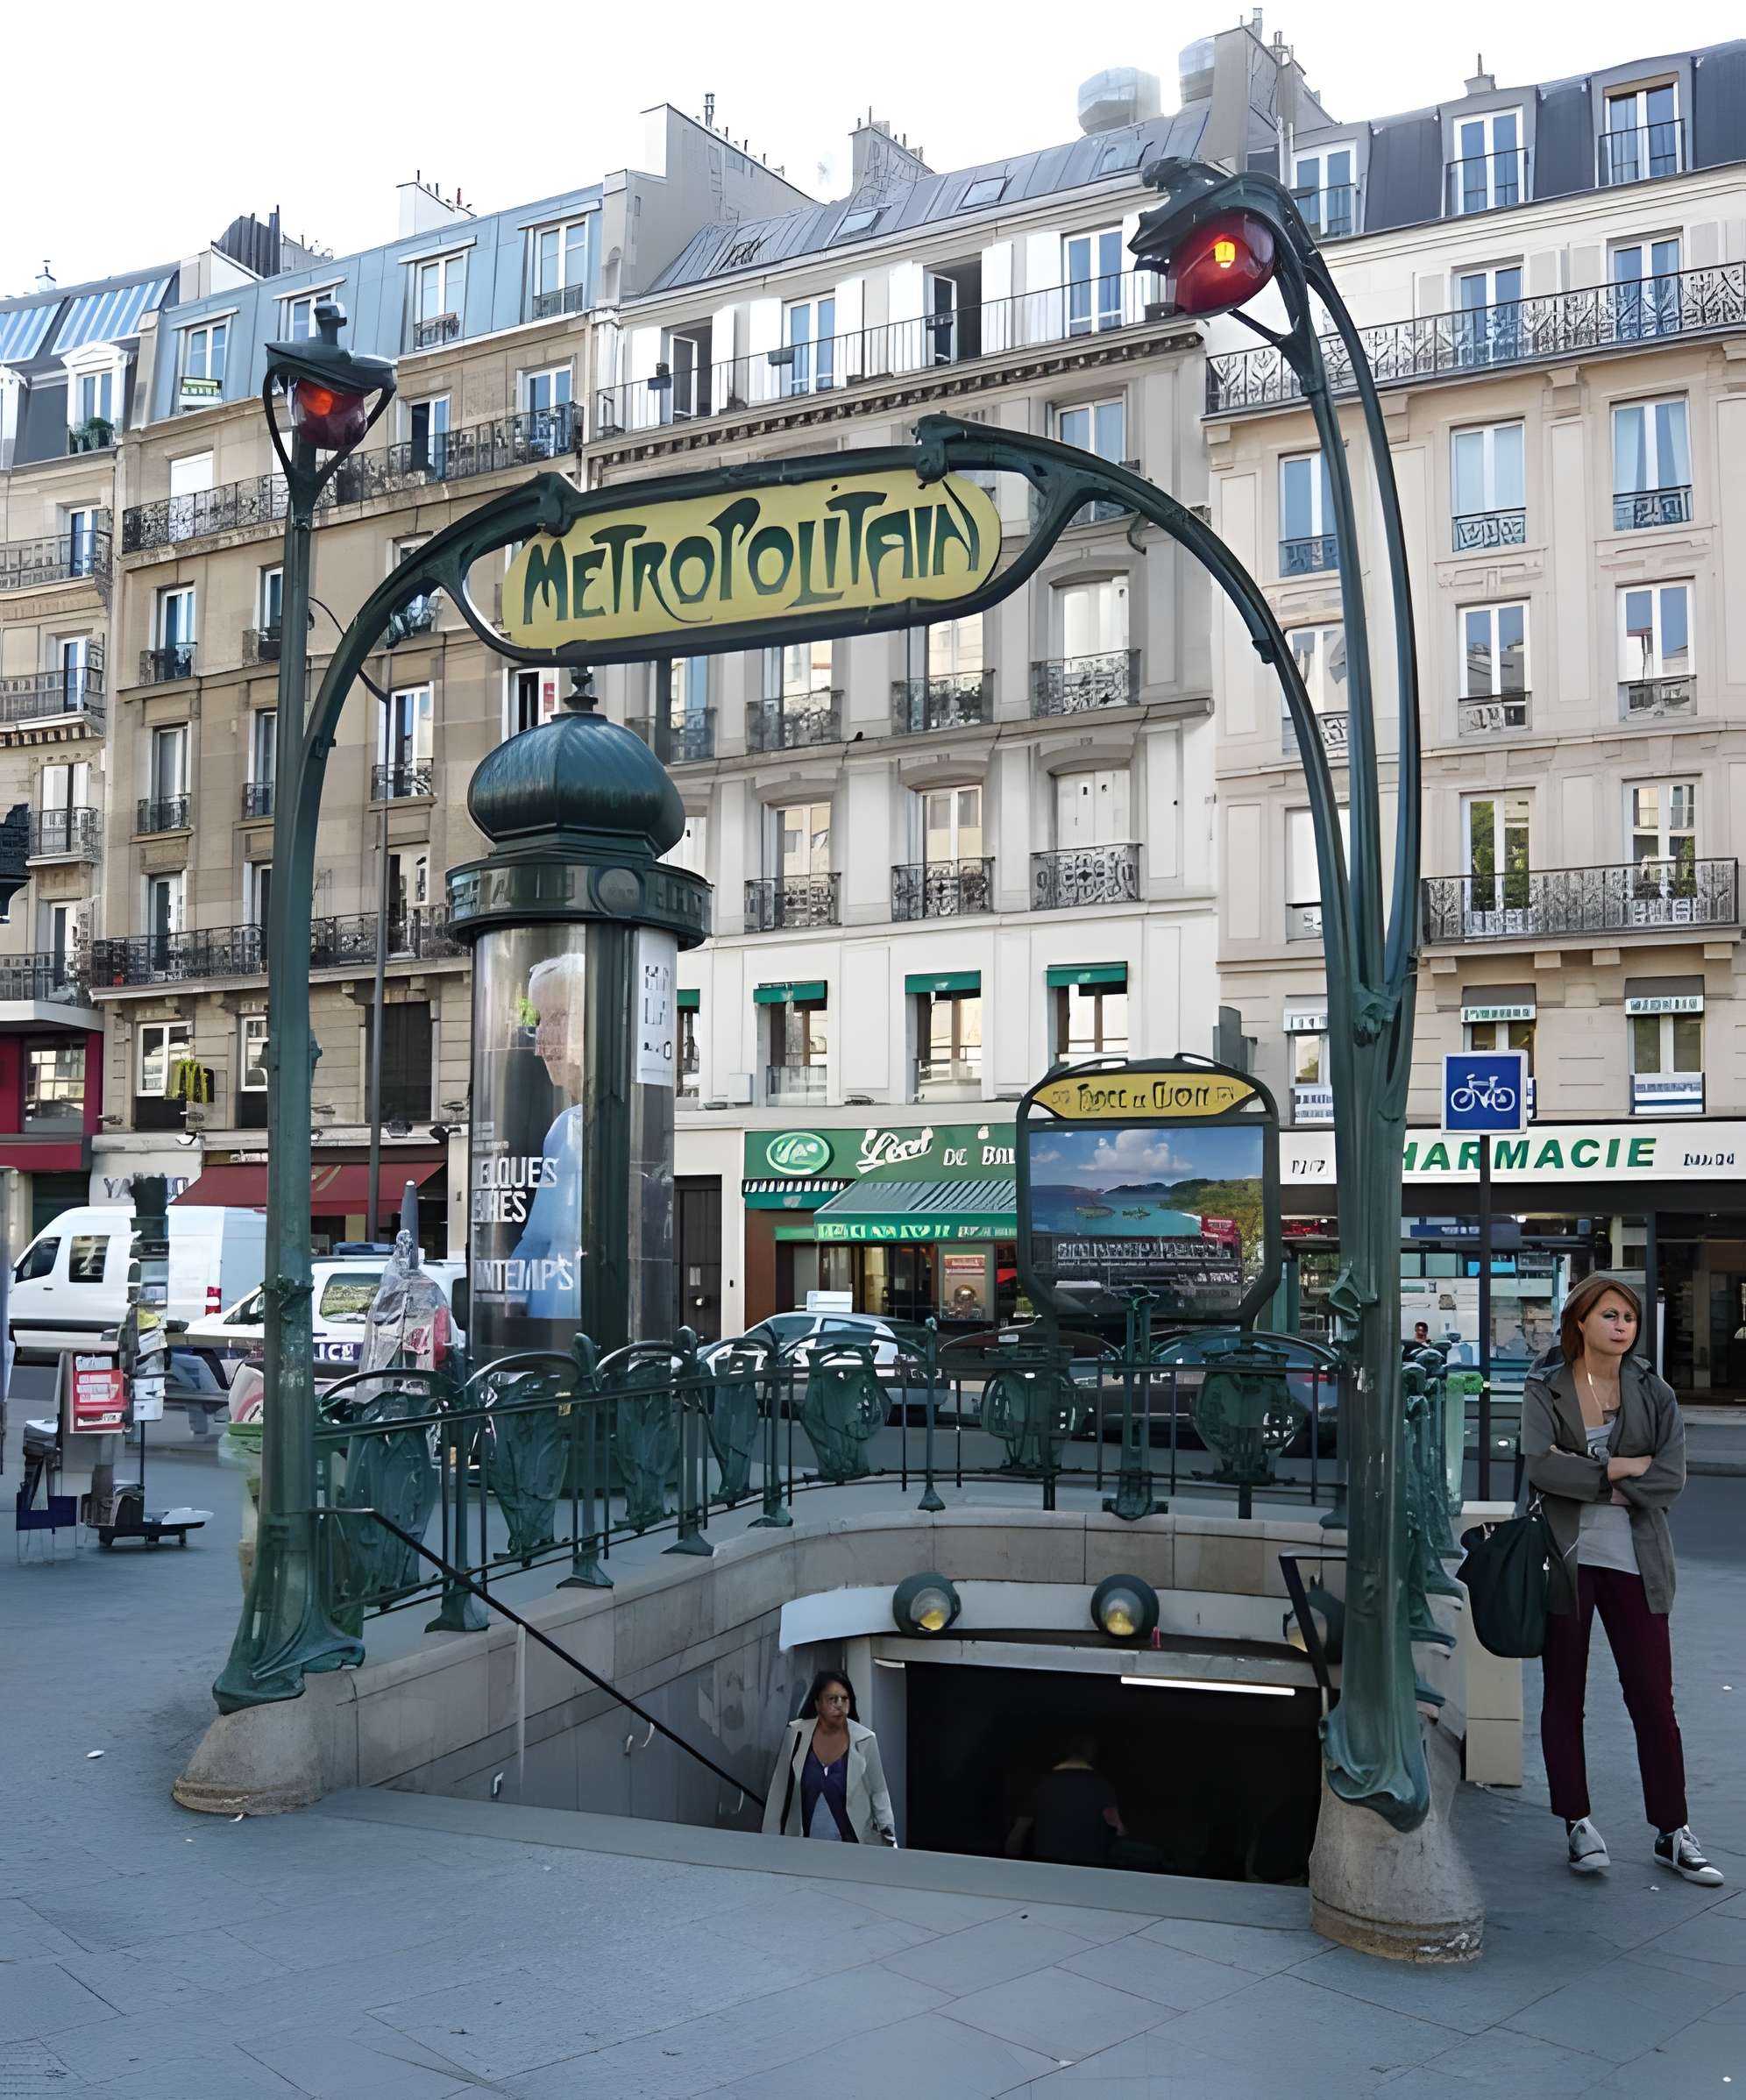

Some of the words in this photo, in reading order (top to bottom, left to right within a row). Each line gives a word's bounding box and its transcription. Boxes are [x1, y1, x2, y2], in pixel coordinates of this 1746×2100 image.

[522, 479, 979, 626] METROPOLITAIN
[1402, 1138, 1657, 1171] HARMACIE
[313, 1343, 354, 1361] ICE
